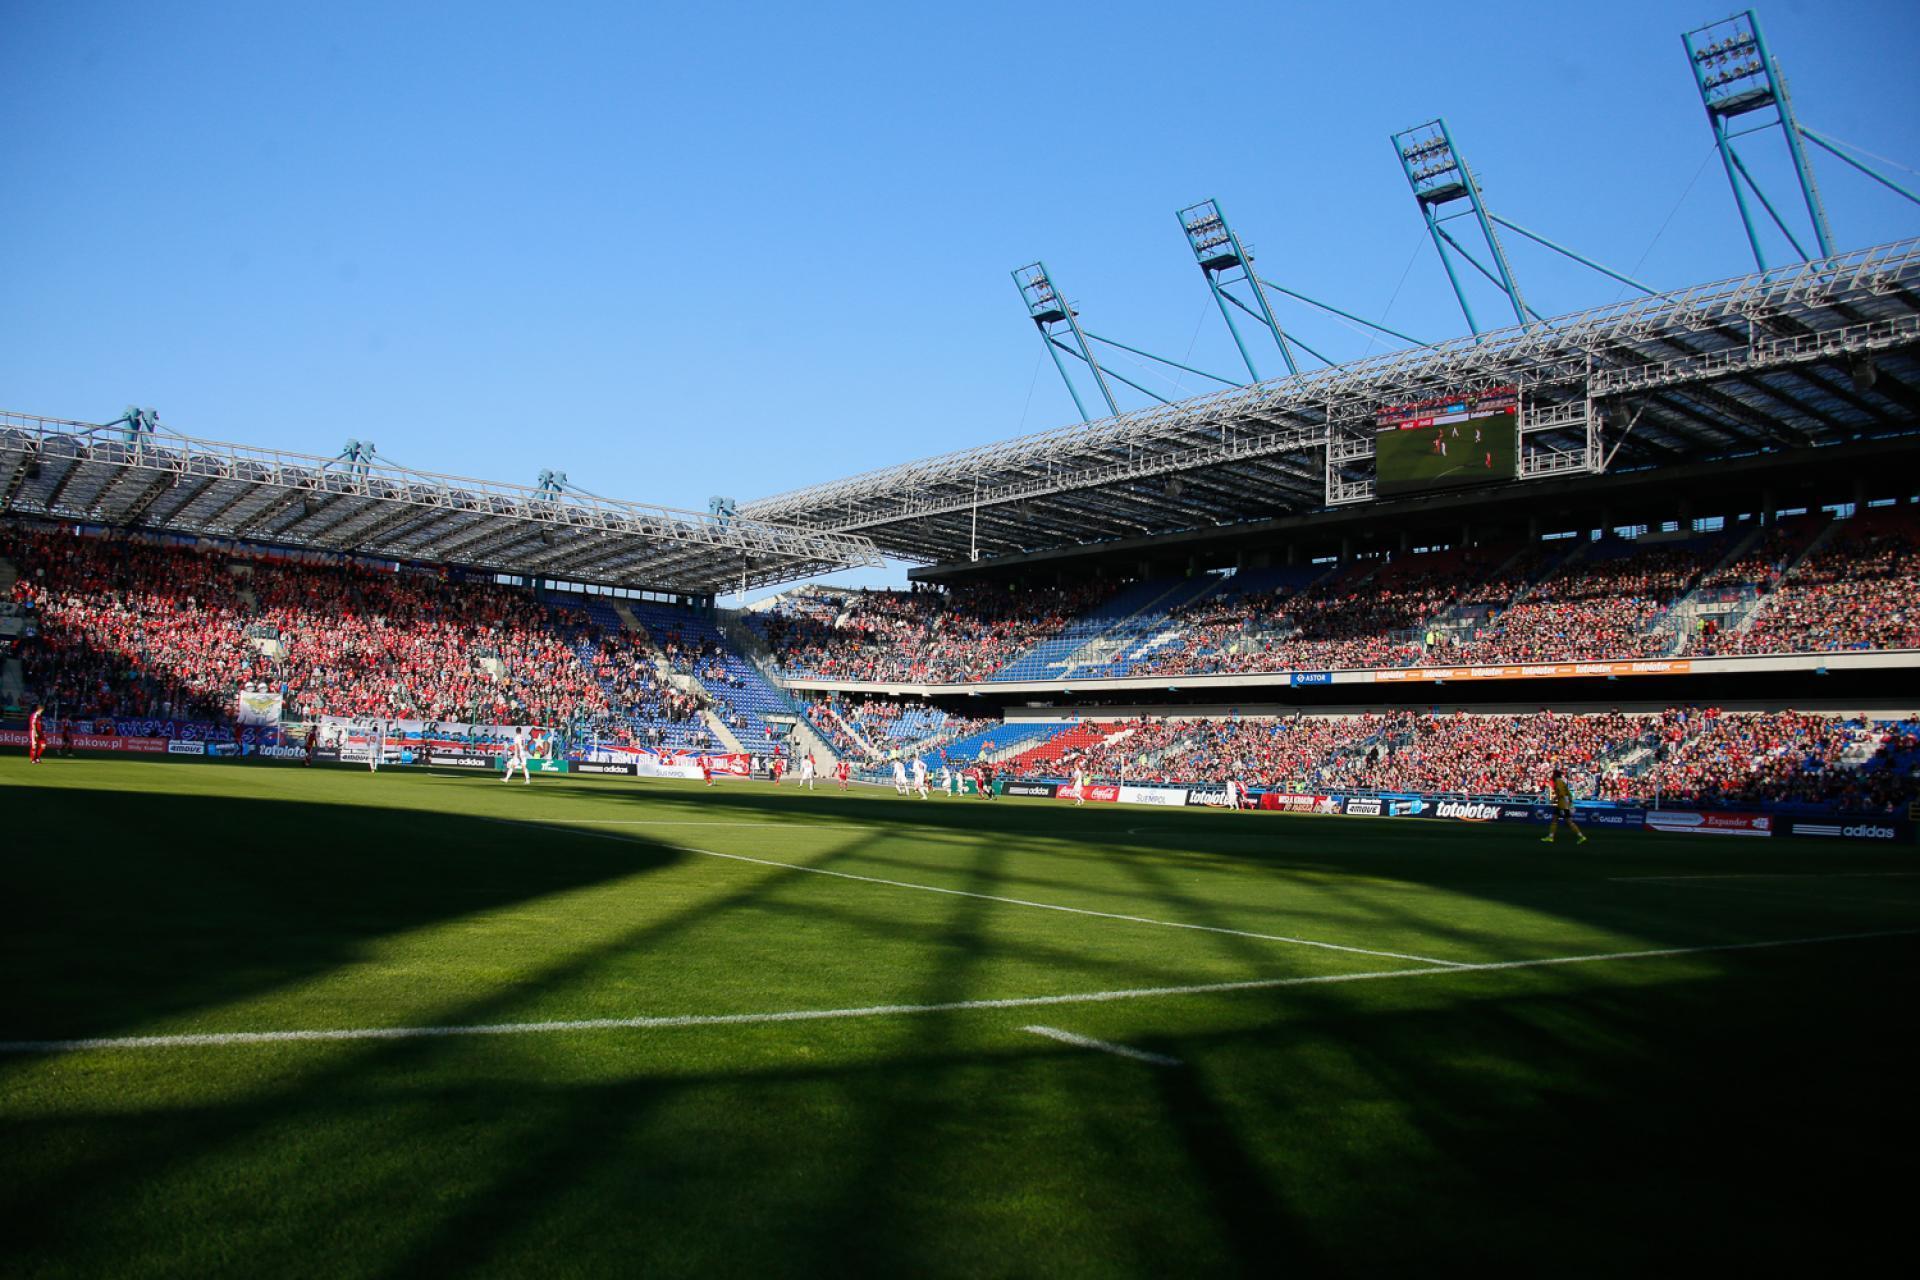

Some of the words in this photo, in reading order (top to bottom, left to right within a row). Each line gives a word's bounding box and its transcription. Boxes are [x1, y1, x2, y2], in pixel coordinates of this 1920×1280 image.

[457, 758, 486, 767] adidas
[604, 766, 628, 774] adidas
[1029, 786, 1049, 795] adidas
[1436, 801, 1501, 819] totolotek
[1708, 816, 1748, 827] Expander
[1843, 824, 1895, 838] adidas
